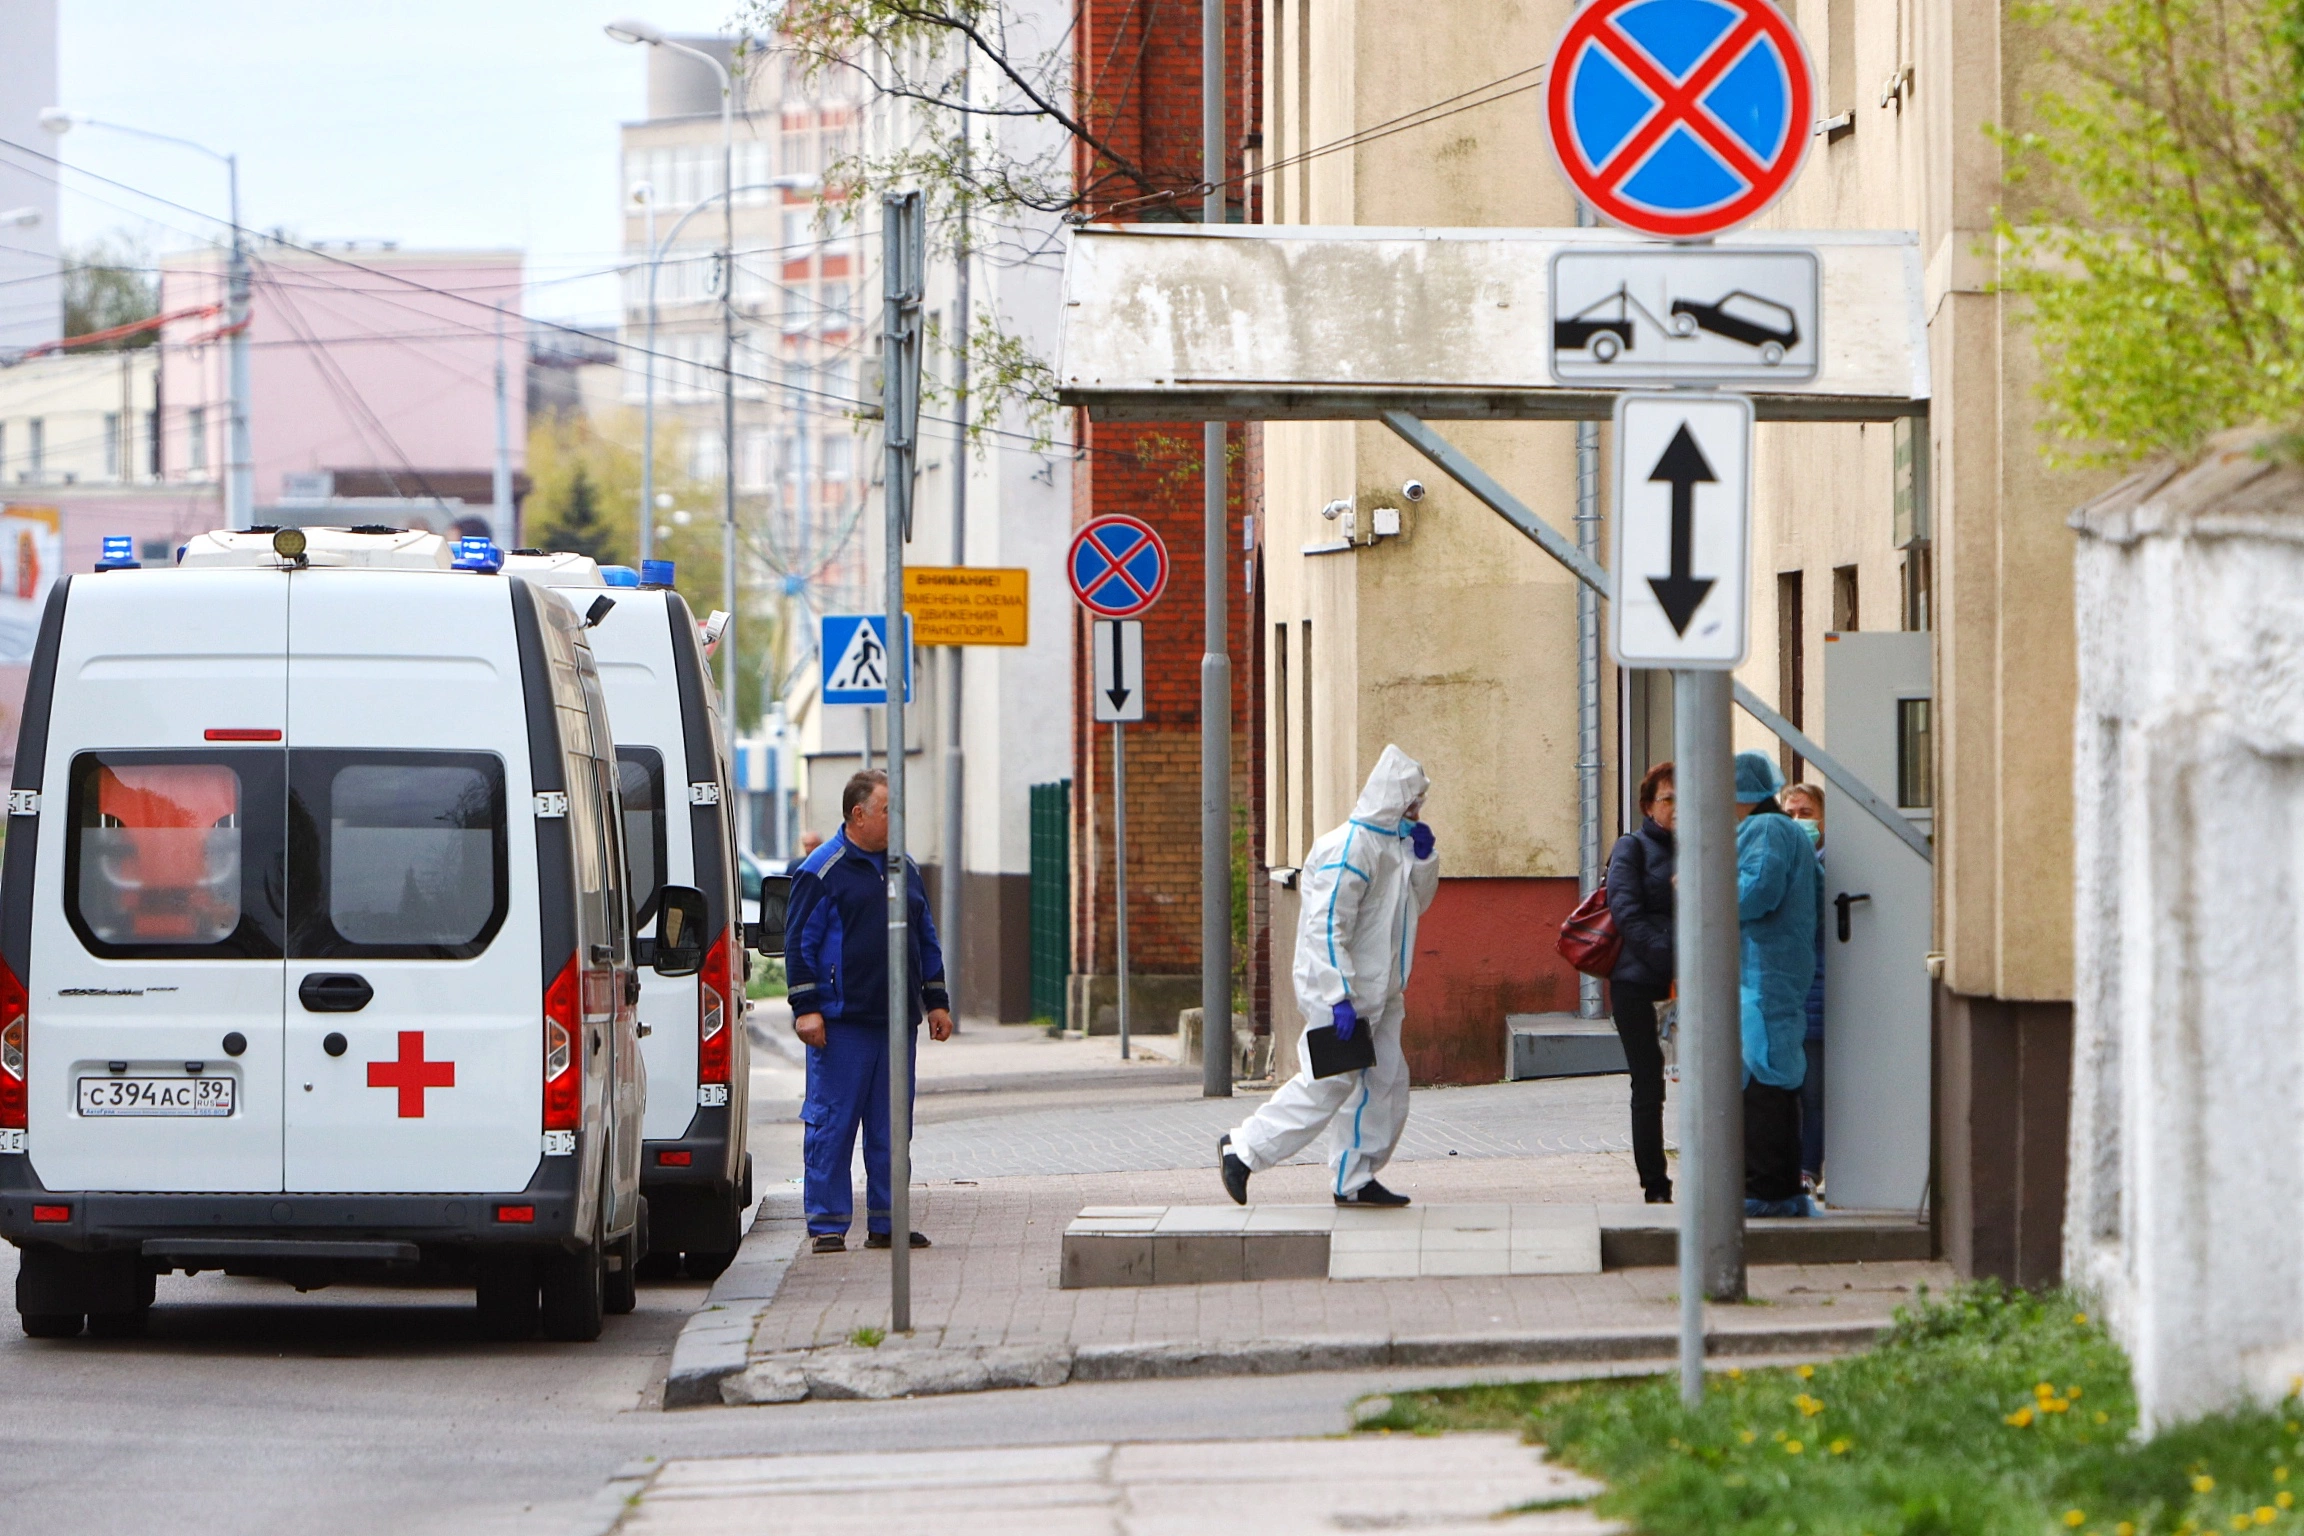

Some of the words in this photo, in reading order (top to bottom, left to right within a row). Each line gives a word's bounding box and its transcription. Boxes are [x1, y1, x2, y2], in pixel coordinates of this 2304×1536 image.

[917, 574, 1000, 587] ВНИМАНИЕ!
[902, 592, 971, 605] ЗМЕНЕНА
[975, 593, 1025, 606] СХЕМА
[918, 608, 999, 621] ДВИЖЕНИЯ
[199, 1082, 223, 1099] 39
[197, 1099, 215, 1107] RUS
